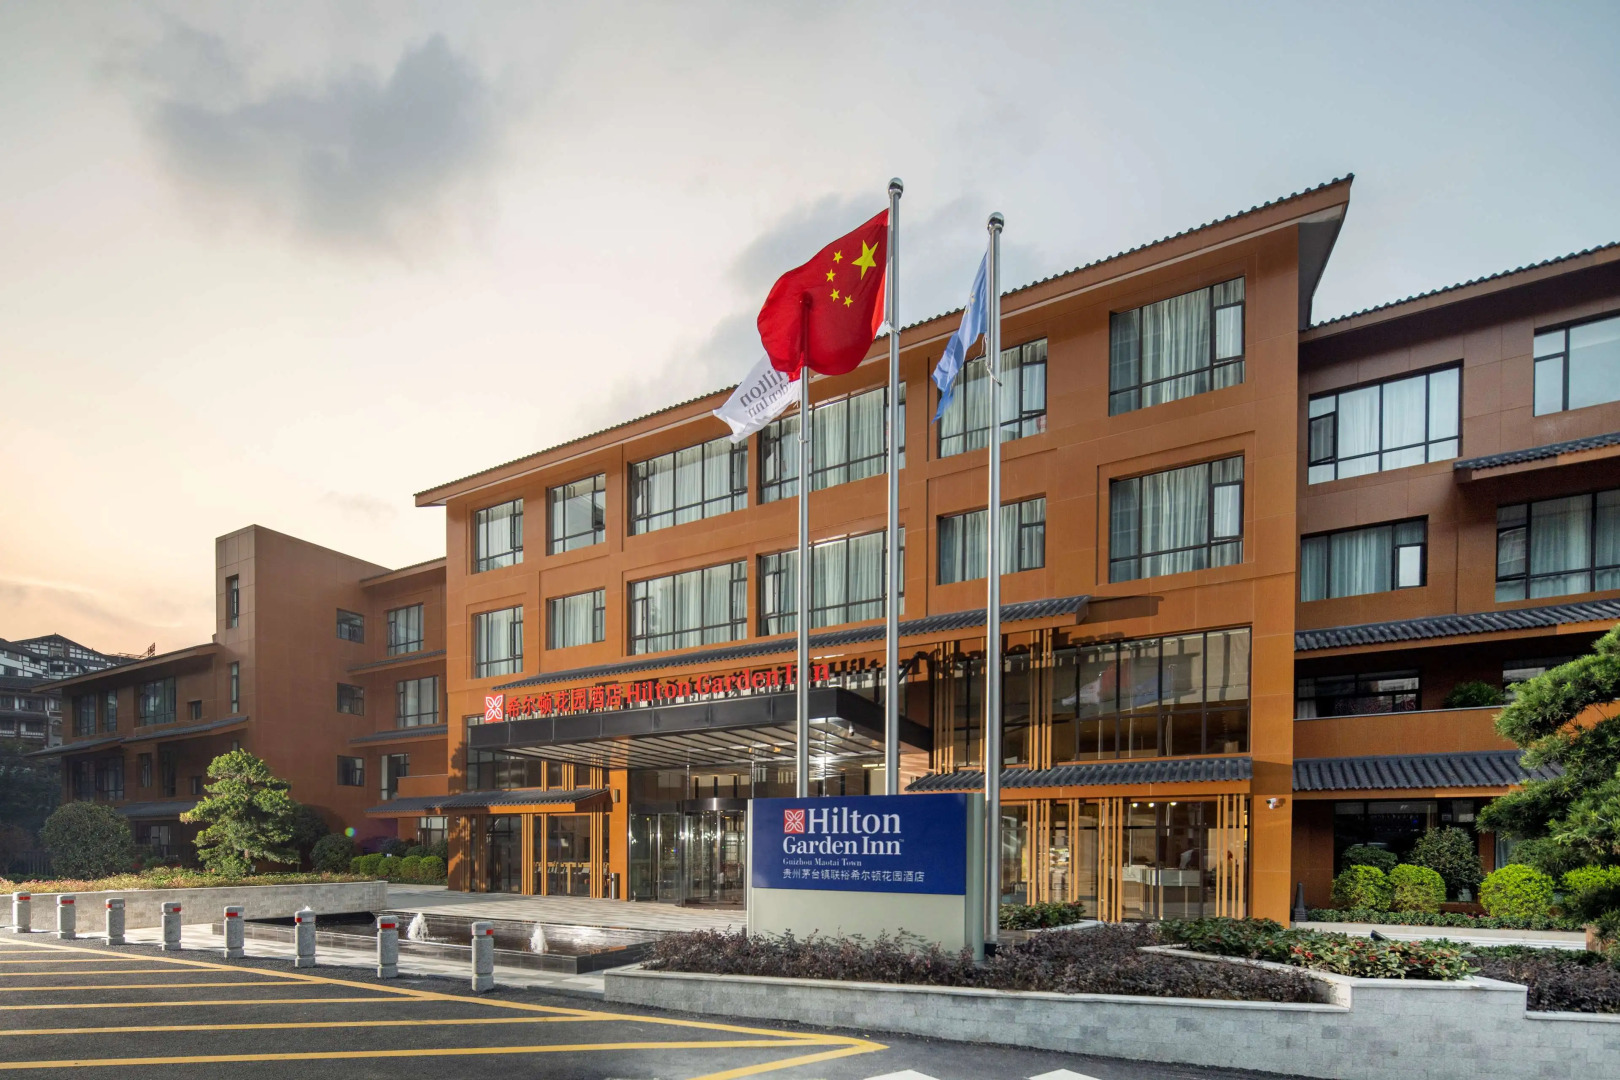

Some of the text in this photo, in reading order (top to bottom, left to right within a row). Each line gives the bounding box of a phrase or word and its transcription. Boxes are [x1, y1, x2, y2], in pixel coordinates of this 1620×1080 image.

[507, 684, 622, 717] 希尔顿花园酒店
[626, 680, 691, 704] Hilton
[696, 668, 779, 695] Garden
[808, 807, 901, 834] Hilton
[783, 836, 901, 855] Garden Inn
[782, 858, 862, 867] Guizhou Maotai Town
